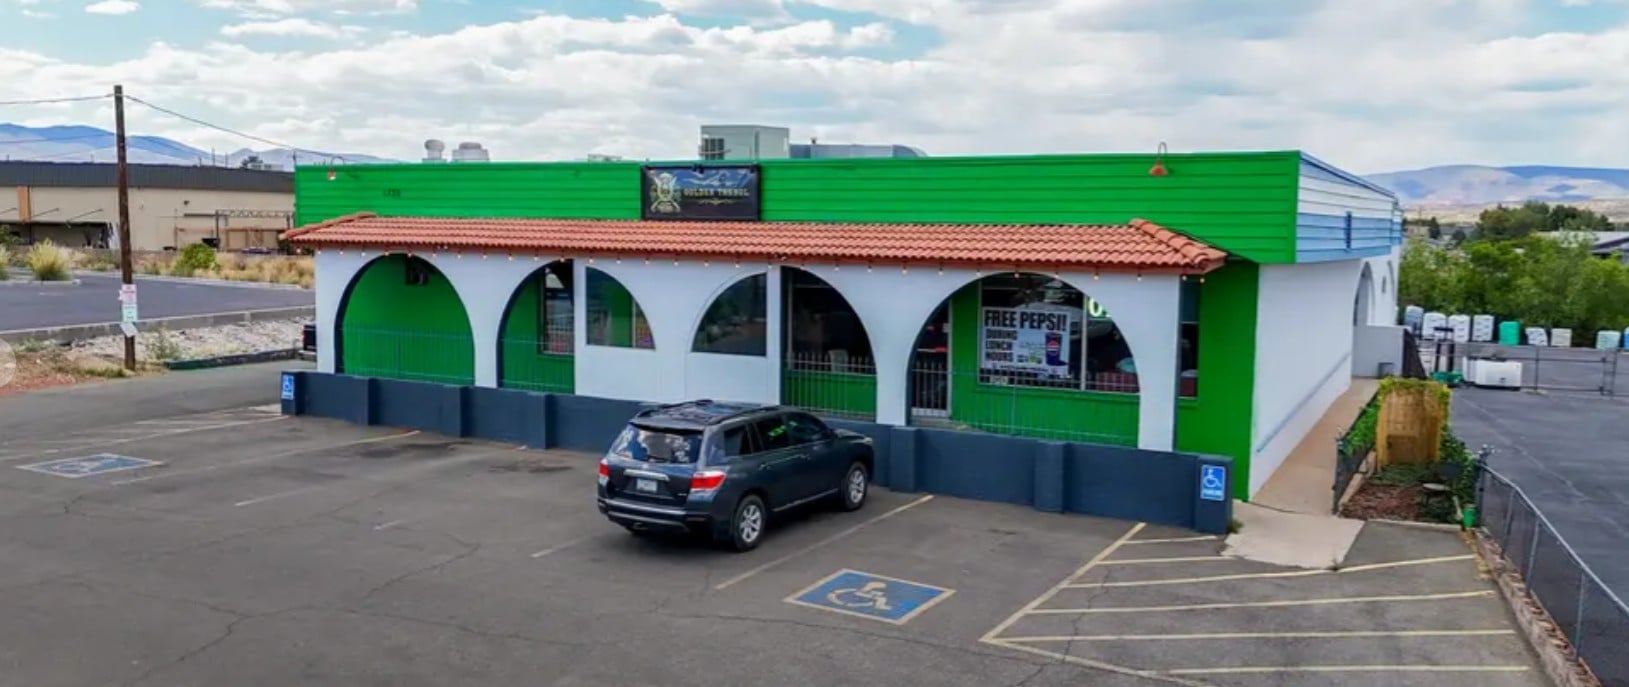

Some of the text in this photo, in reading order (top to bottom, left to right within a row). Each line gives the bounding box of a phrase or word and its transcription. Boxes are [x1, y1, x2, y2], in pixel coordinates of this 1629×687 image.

[683, 188, 714, 196] GOLDEN
[985, 310, 1017, 327] FREE
[986, 329, 1017, 340] DURING
[986, 340, 1012, 350] LUNCH
[986, 351, 1013, 362] HOURS
